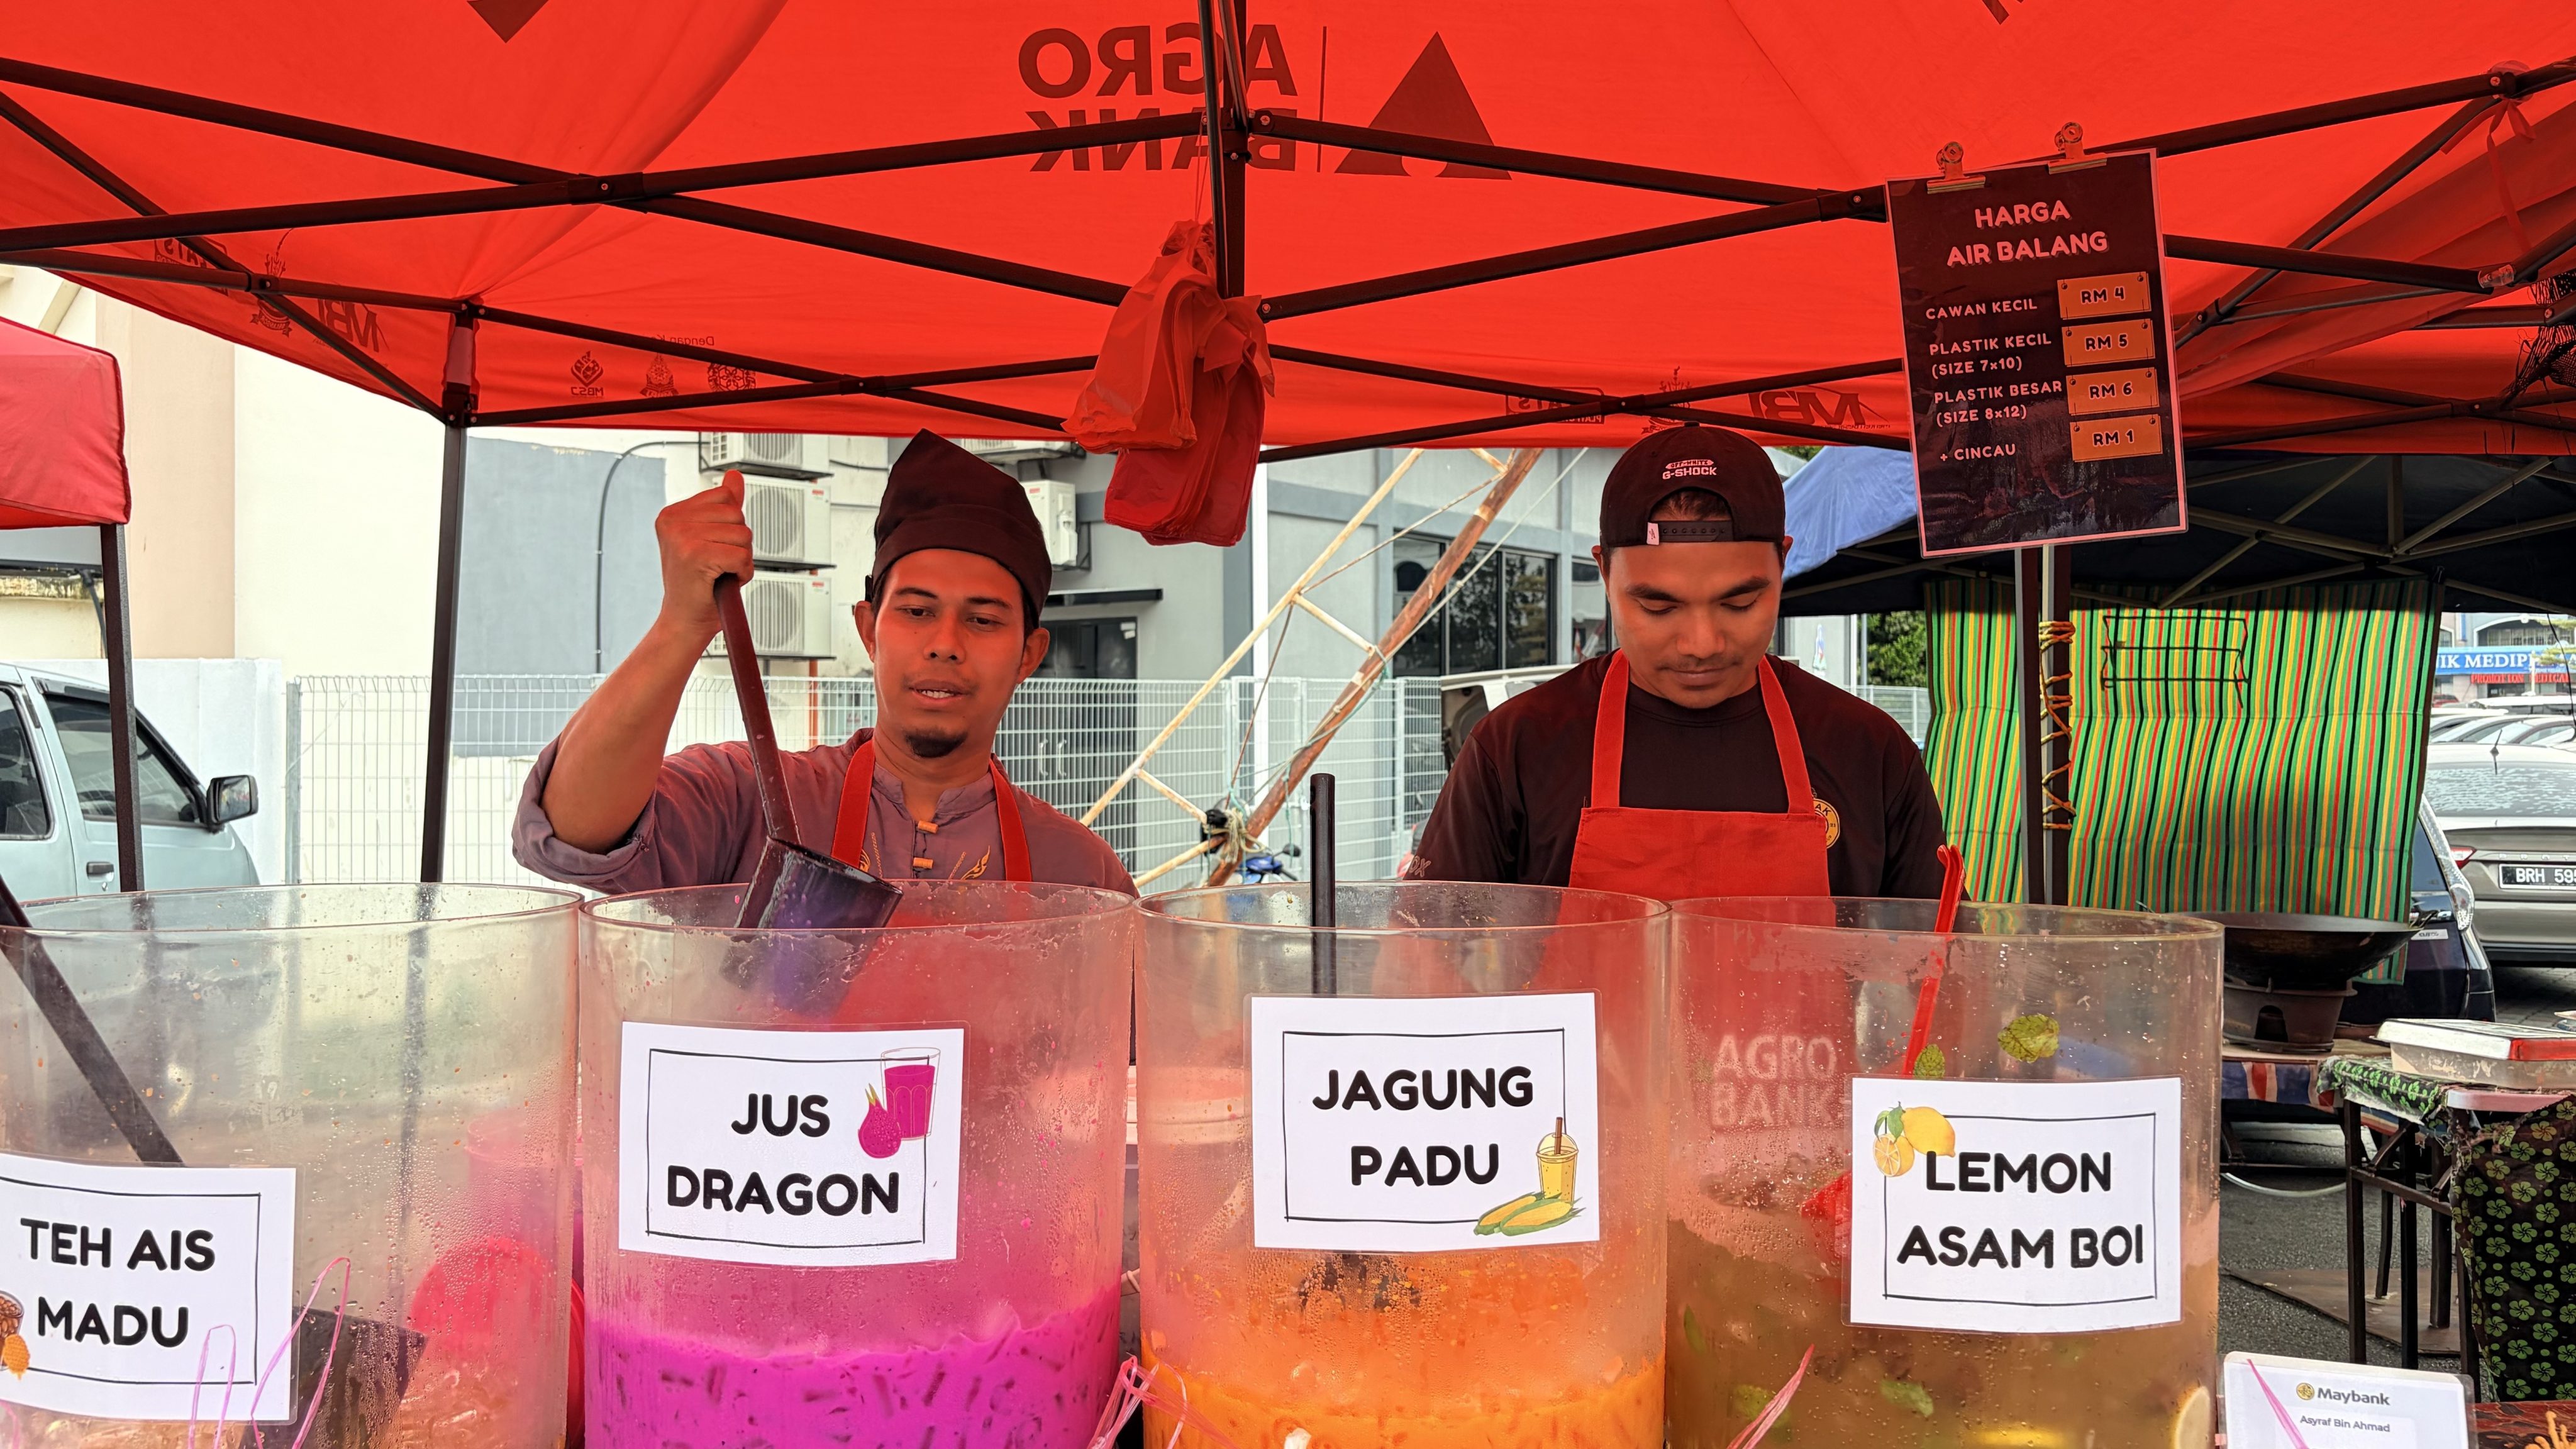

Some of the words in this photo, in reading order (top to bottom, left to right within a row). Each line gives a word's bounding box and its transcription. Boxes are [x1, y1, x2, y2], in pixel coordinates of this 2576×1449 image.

[1975, 201, 2070, 228] HARGA
[1947, 244, 1990, 266] AIR
[1997, 231, 2107, 260] BALANG
[2081, 289, 2107, 304] RM
[2114, 287, 2125, 301] 4
[1926, 304, 1985, 319] CAWAN
[1993, 299, 2036, 312] KECIL
[1930, 338, 1998, 355] PLASTIK
[2006, 334, 2051, 347] KECIL
[2085, 337, 2111, 352] RM
[2118, 334, 2128, 347] 5
[1933, 362, 1974, 379] (SIZE
[1980, 357, 2021, 370] 7x10)
[1935, 387, 2002, 403] PLASTIK
[2010, 381, 2061, 396] BESAR
[2089, 385, 2116, 399] RM
[2123, 382, 2133, 396] 6
[1937, 410, 1978, 427] (SIZE
[1986, 405, 2026, 419] 8x12)
[2093, 433, 2119, 447] RM
[2126, 430, 2134, 443] 1
[1955, 444, 2015, 460] CINCAU
[1663, 464, 1716, 479] G-SHOCK
[2437, 653, 2460, 669] IK
[2516, 869, 2545, 882] BRH
[1713, 1035, 1838, 1080] AGRO
[1313, 1067, 1533, 1110] JAGUNG
[1710, 1082, 1835, 1126] BANK
[731, 1094, 830, 1137] JUS
[1352, 1144, 1498, 1186] PADU
[1927, 1151, 2111, 1193] LEMON
[668, 1165, 899, 1216] DRAGON
[21, 1219, 111, 1267] TEH
[128, 1230, 214, 1271] AIS
[1897, 1226, 2053, 1268] ASAM
[2071, 1224, 2143, 1268] BOI
[38, 1297, 187, 1347] MADU
[2318, 1388, 2389, 1405] Maybank
[2301, 1416, 2330, 1426] Asyraf
[2354, 1422, 2389, 1431] Ahmad
